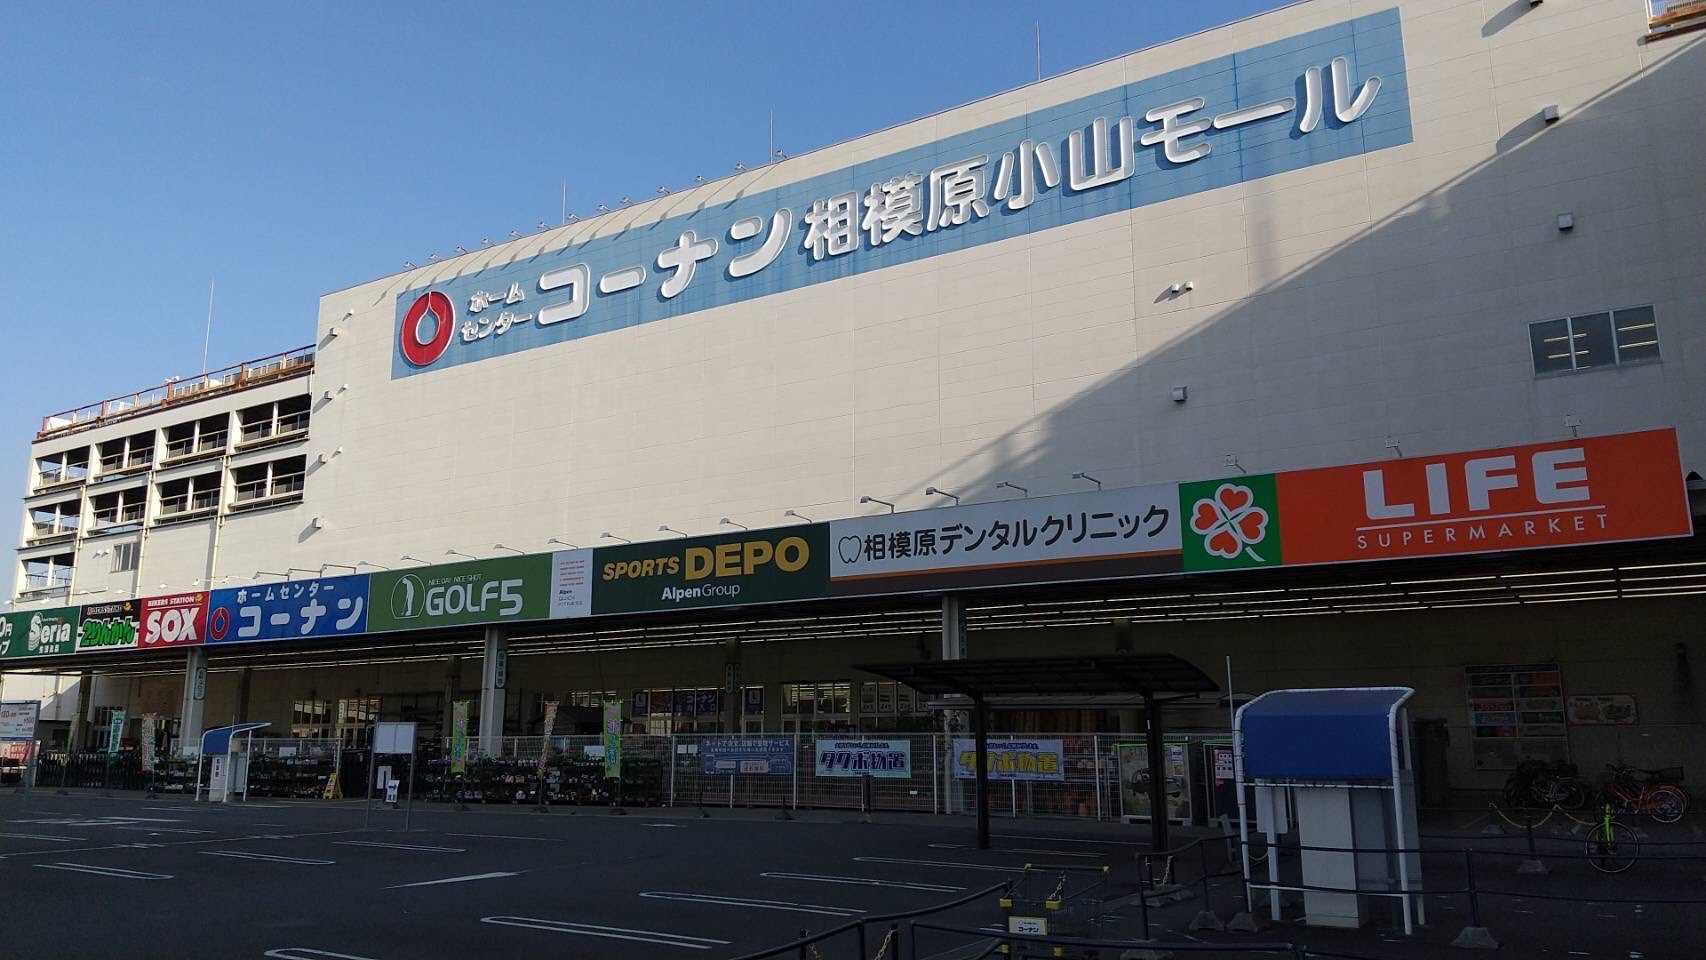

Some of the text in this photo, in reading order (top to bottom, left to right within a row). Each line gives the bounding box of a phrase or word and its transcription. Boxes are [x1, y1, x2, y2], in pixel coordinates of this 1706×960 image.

[538, 56, 1382, 326] コーナン 相模原小山モール
[470, 281, 527, 313] ホーム
[462, 311, 532, 342] センター
[1362, 447, 1591, 520] LIFE
[863, 504, 1169, 562] 相模原デンタルクリニック
[1356, 513, 1608, 550] SUPERMARKET
[602, 556, 680, 581] SPORTS
[684, 536, 811, 581] DEPO
[169, 595, 195, 605] STATION
[237, 581, 335, 604] ホームセンター
[425, 578, 524, 616] GOLF5
[29, 613, 71, 650] Seria
[145, 608, 199, 644] SOX
[237, 596, 363, 637] コーナン
[820, 751, 905, 770] タクボ物置
